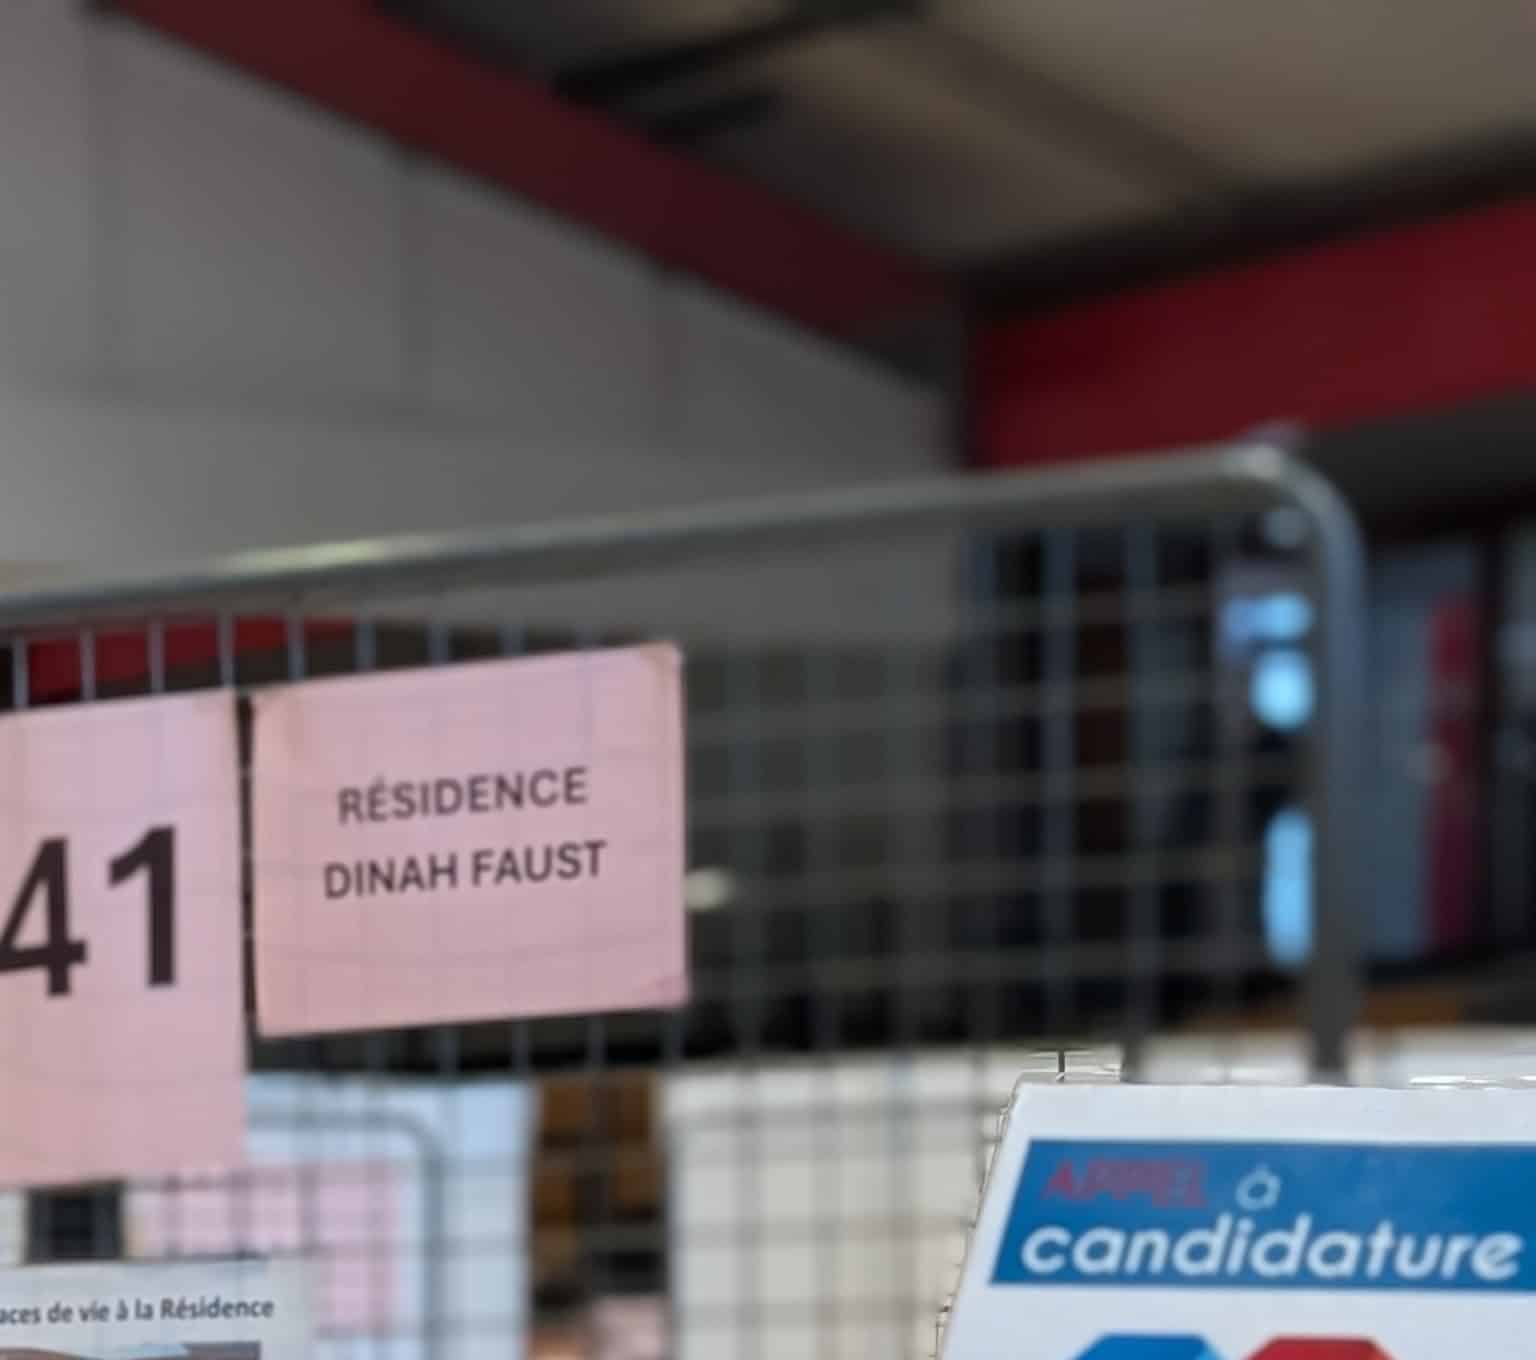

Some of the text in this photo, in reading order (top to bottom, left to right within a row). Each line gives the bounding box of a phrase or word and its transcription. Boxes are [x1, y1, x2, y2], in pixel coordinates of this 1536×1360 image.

[337, 767, 588, 824] RÉSIDENCE
[324, 840, 609, 900] DINAH FAUST
[1021, 1211, 1522, 1281] candidature
[47, 1304, 72, 1324] de
[79, 1302, 109, 1323] vie
[117, 1299, 128, 1321] à
[135, 1297, 154, 1321] la
[161, 1295, 275, 1320] Résidence
